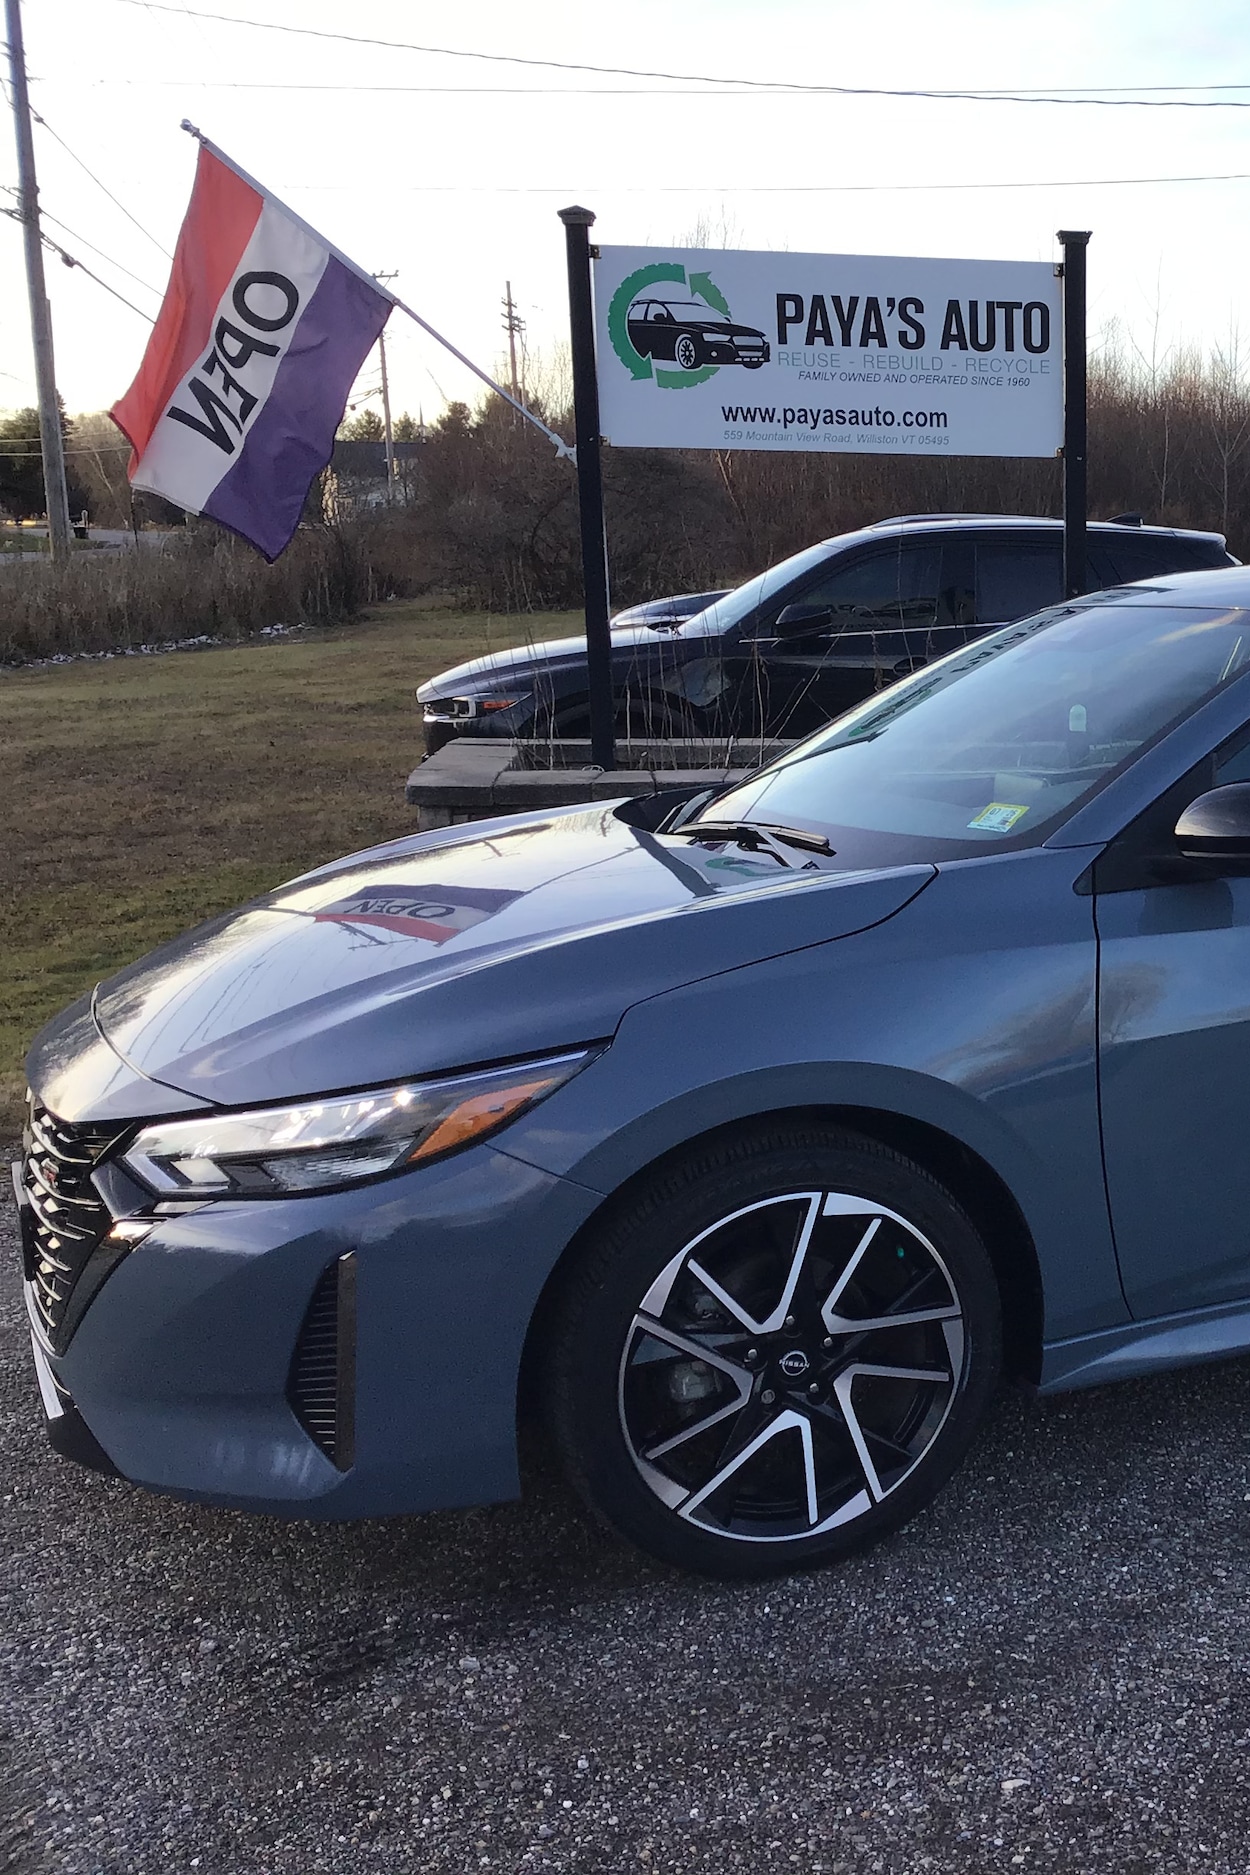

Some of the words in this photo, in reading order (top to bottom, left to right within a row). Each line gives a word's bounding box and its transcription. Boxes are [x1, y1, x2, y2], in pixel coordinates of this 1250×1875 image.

[776, 293, 925, 350] PAYA'S
[940, 299, 1050, 354] AUTO
[777, 351, 841, 368] REUSE
[863, 354, 943, 371] REBUILD
[965, 357, 1051, 374] RECYCLE
[798, 370, 838, 381] FAMILY
[839, 372, 882, 383] OWNED
[883, 373, 907, 384] AND
[909, 374, 969, 386] OPERATED
[970, 376, 1005, 387] SINCE
[1007, 377, 1031, 387] 1960
[721, 405, 948, 430] www.payasauto.com
[723, 430, 743, 440] 559
[745, 431, 793, 442] Mountain
[795, 432, 821, 443] View
[823, 432, 853, 445] Road,
[856, 433, 899, 445] Williston
[901, 435, 916, 445] VT
[917, 435, 950, 446] 05495
[779, 1359, 810, 1368] NISSAN
